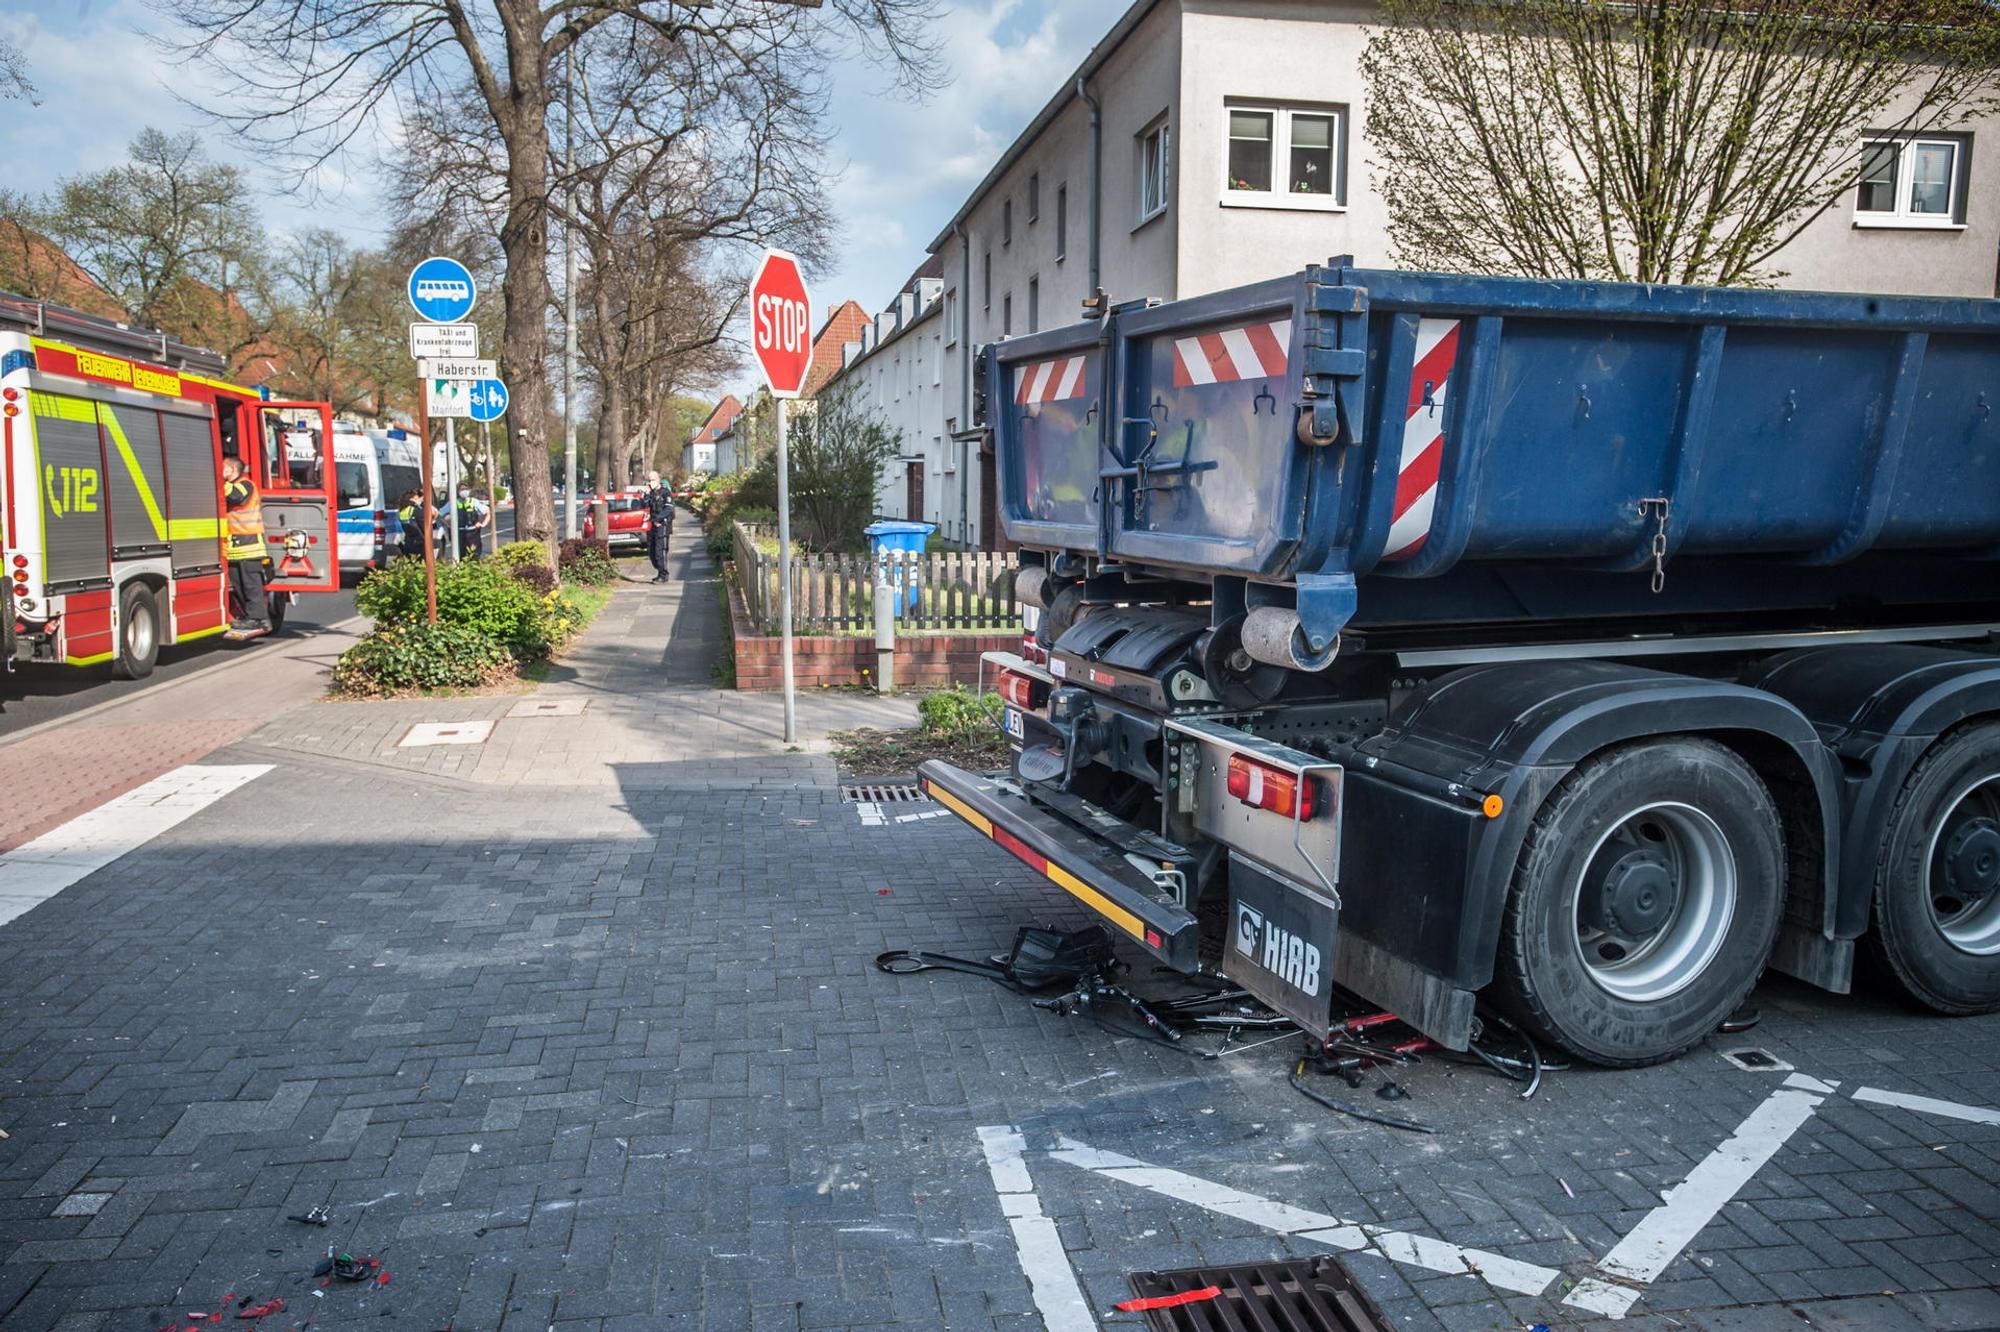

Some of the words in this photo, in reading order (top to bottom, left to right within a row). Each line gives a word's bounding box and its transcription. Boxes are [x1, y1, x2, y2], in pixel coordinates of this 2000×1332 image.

[758, 293, 807, 354] STOP
[416, 338, 472, 347] Krankenfahrzeuge
[440, 347, 451, 355] frei
[437, 362, 488, 376] Haberstr.
[432, 405, 464, 415] Manfort
[60, 467, 98, 512] 112
[1263, 920, 1321, 997] HIAB
